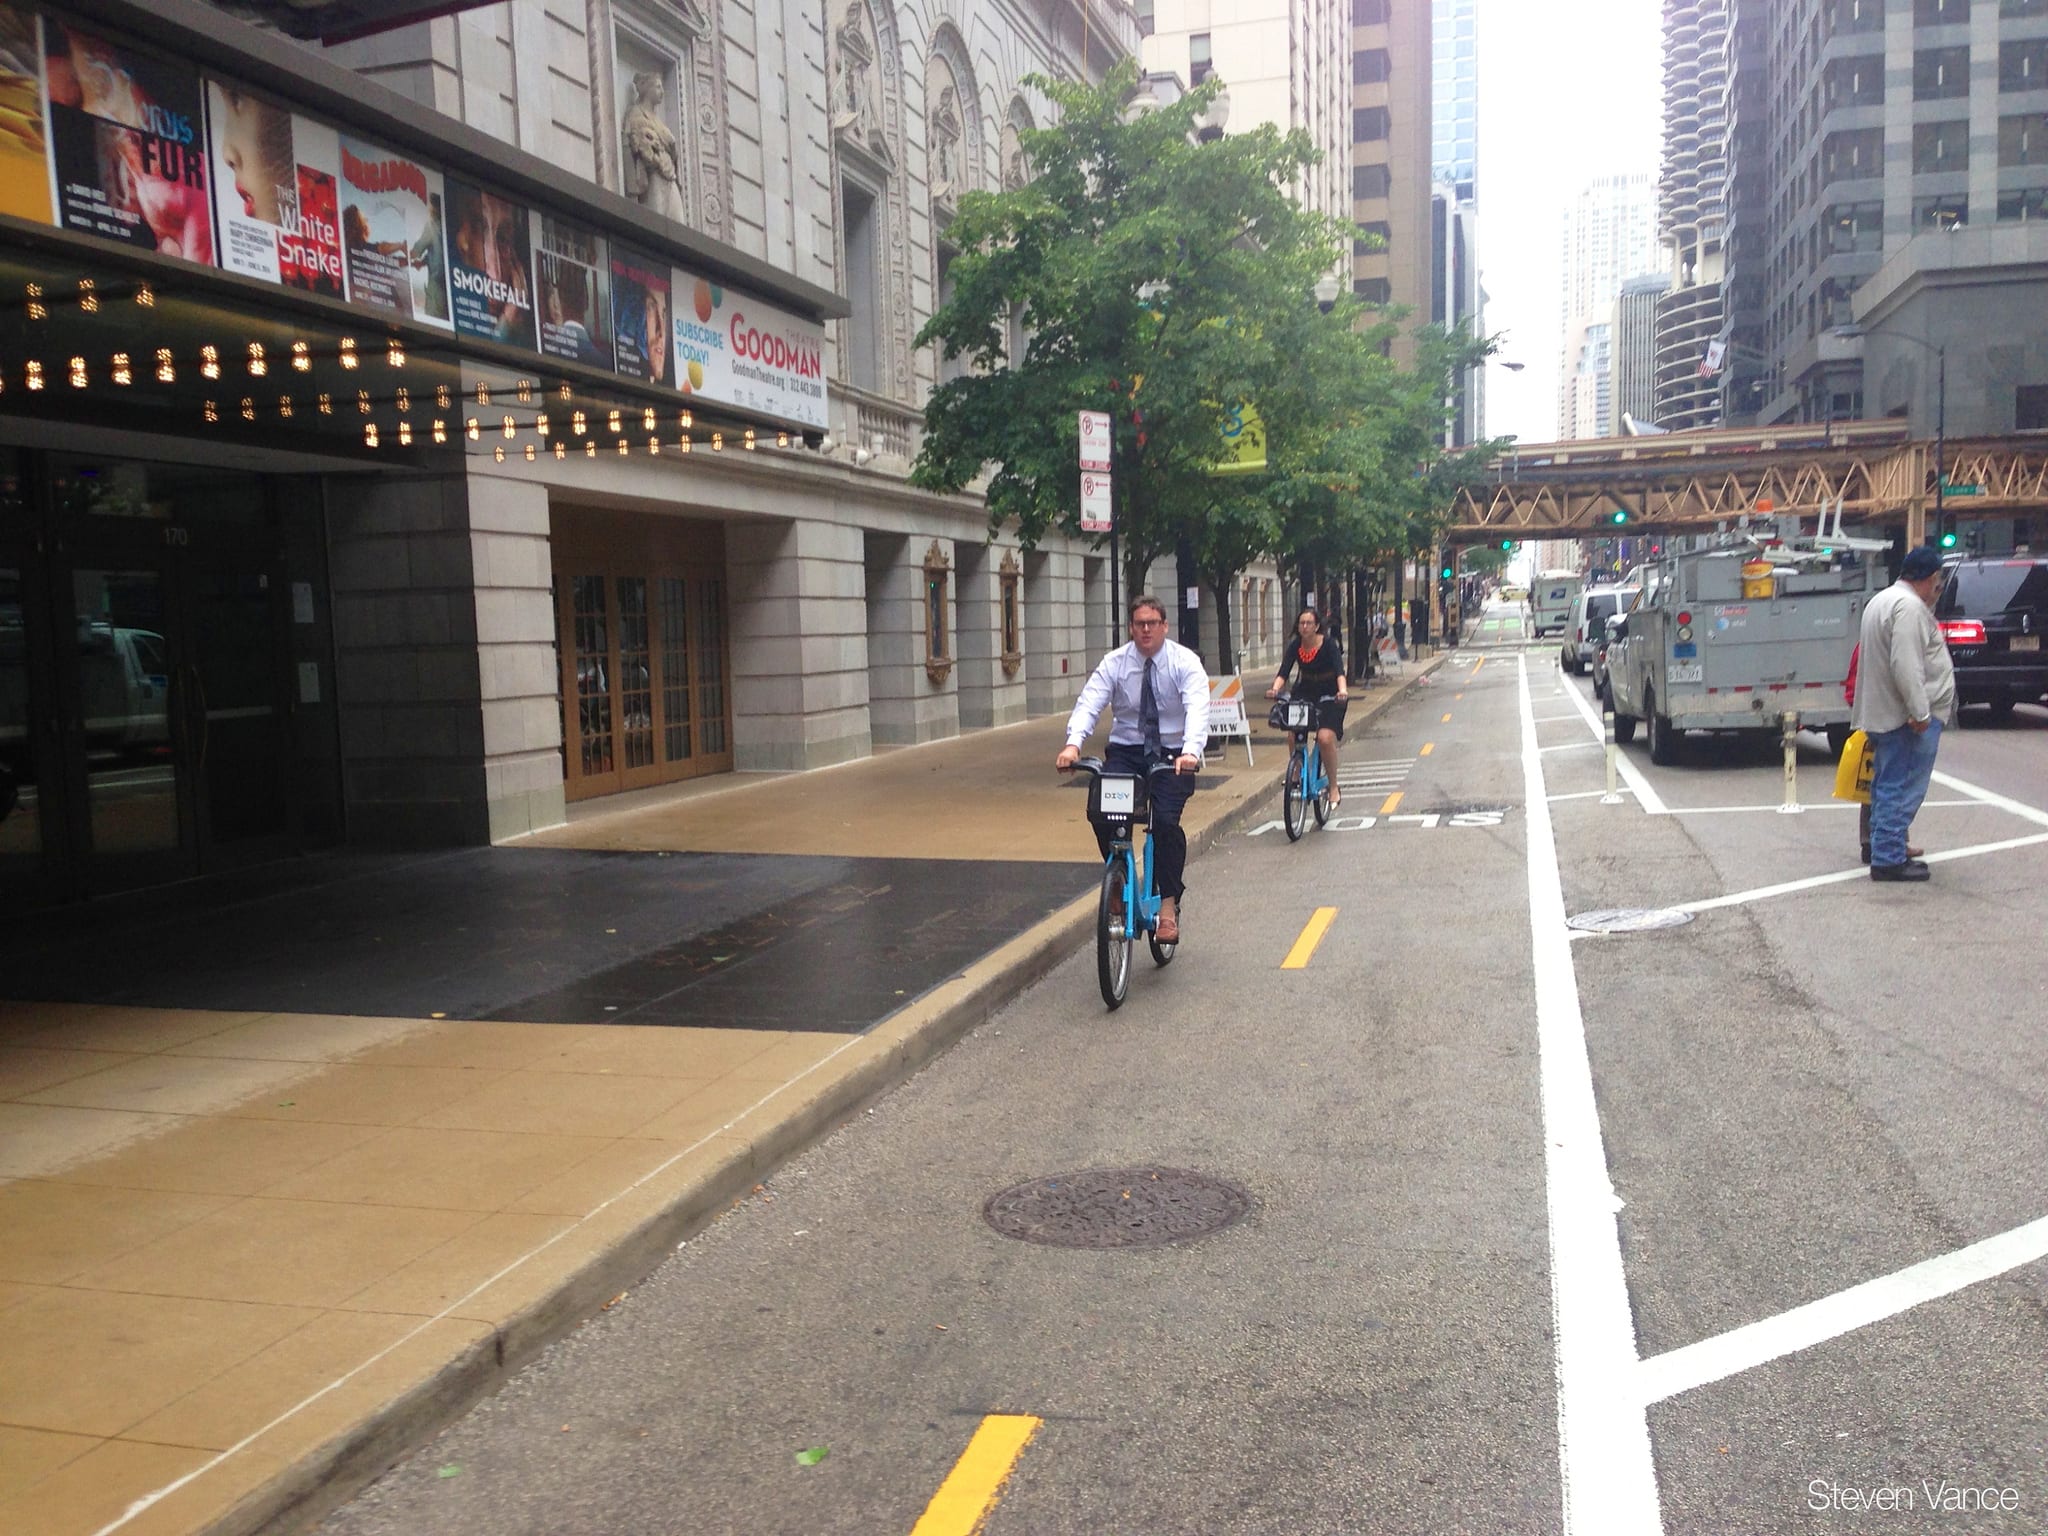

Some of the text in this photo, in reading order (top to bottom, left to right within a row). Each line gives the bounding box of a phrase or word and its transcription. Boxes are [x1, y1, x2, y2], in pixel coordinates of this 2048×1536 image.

[142, 132, 204, 190] FUR
[275, 184, 296, 204] THE
[278, 202, 335, 246] White
[279, 232, 341, 278] Snake
[453, 267, 531, 310] SMOKEFALL
[676, 318, 724, 350] SUBSCRIBE
[730, 312, 822, 380] GOODMAN
[676, 341, 710, 366] TODAY!
[731, 358, 786, 392] GoodmanTheatre.org
[164, 527, 189, 546] 170
